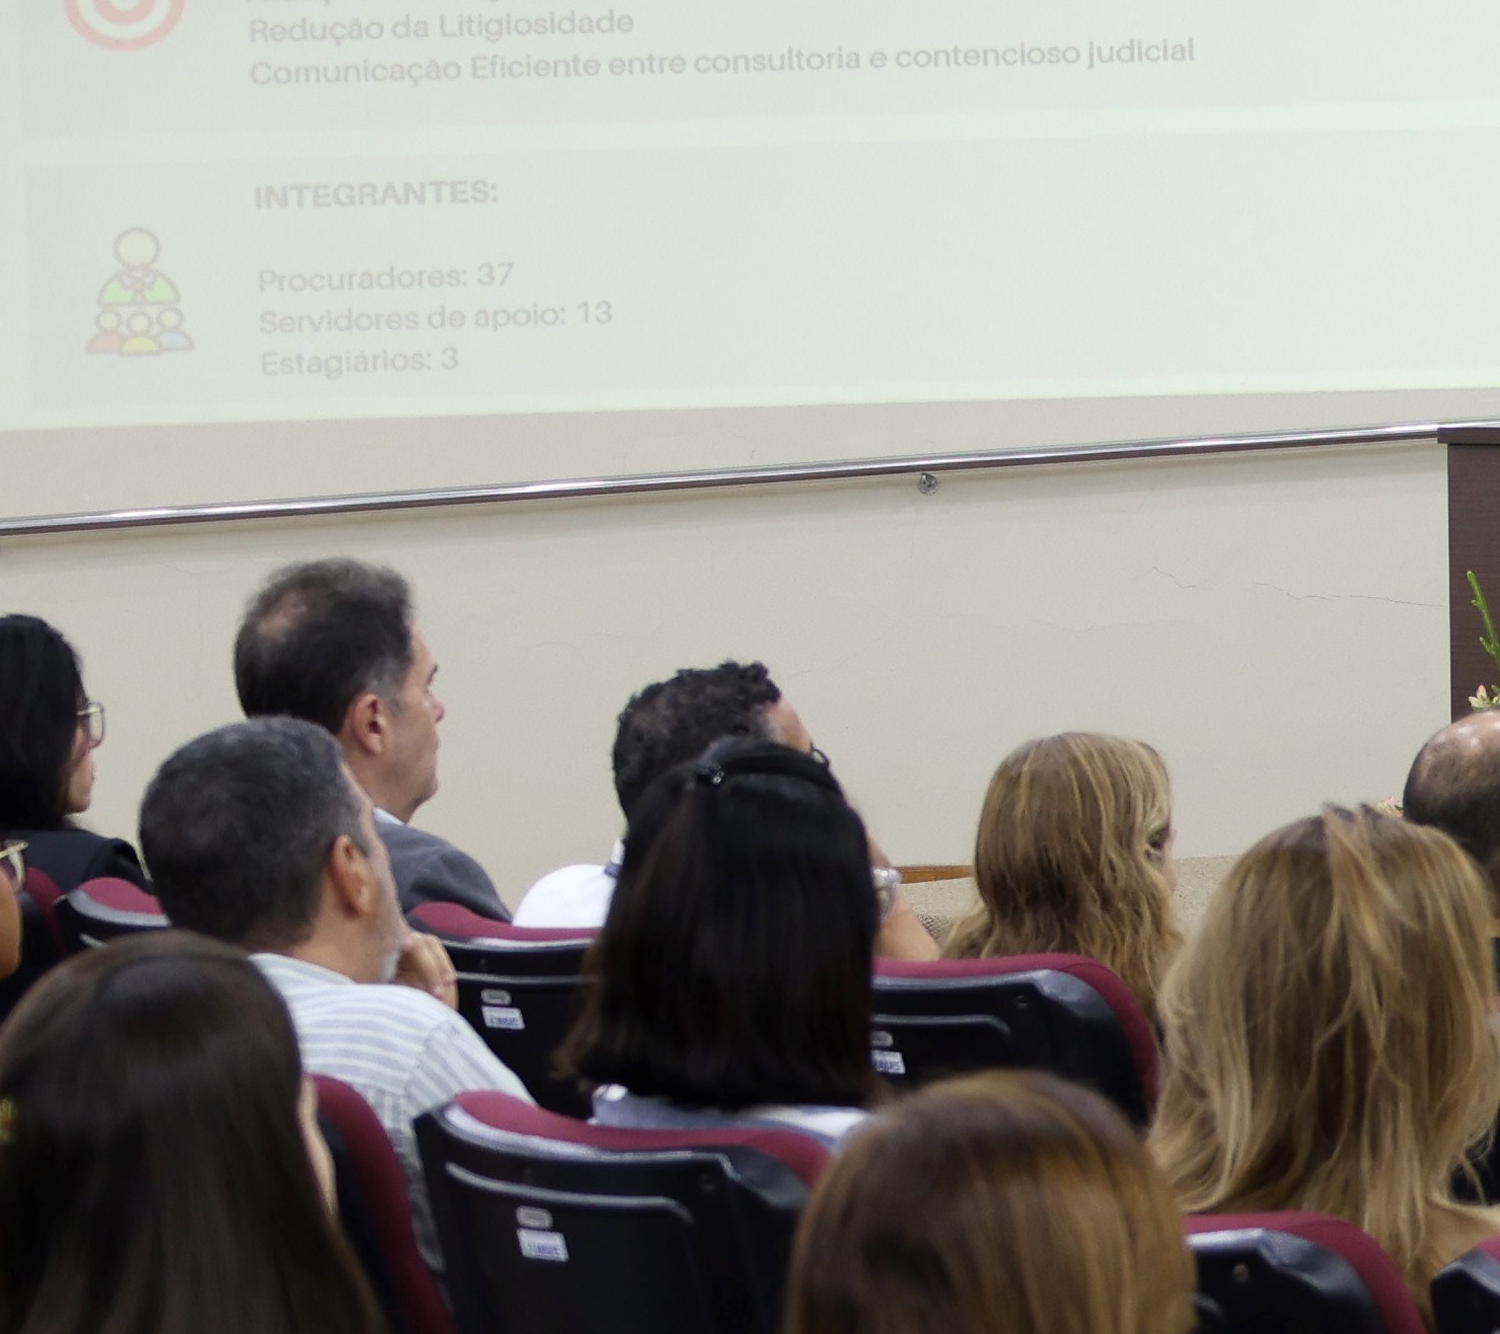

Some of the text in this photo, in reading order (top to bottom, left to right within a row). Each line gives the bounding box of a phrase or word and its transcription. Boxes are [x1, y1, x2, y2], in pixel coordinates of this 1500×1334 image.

[250, 8, 634, 48] Redução da Litigiosidade
[250, 36, 1195, 88] Comunicação Eficiente entre consultoria e contencioso judicial
[254, 182, 498, 208] INTEGRANTES:
[258, 261, 514, 293] Procuradores: 37
[259, 300, 613, 335] Servidores de apoio: 13
[262, 345, 459, 379] Estagiários: 3
